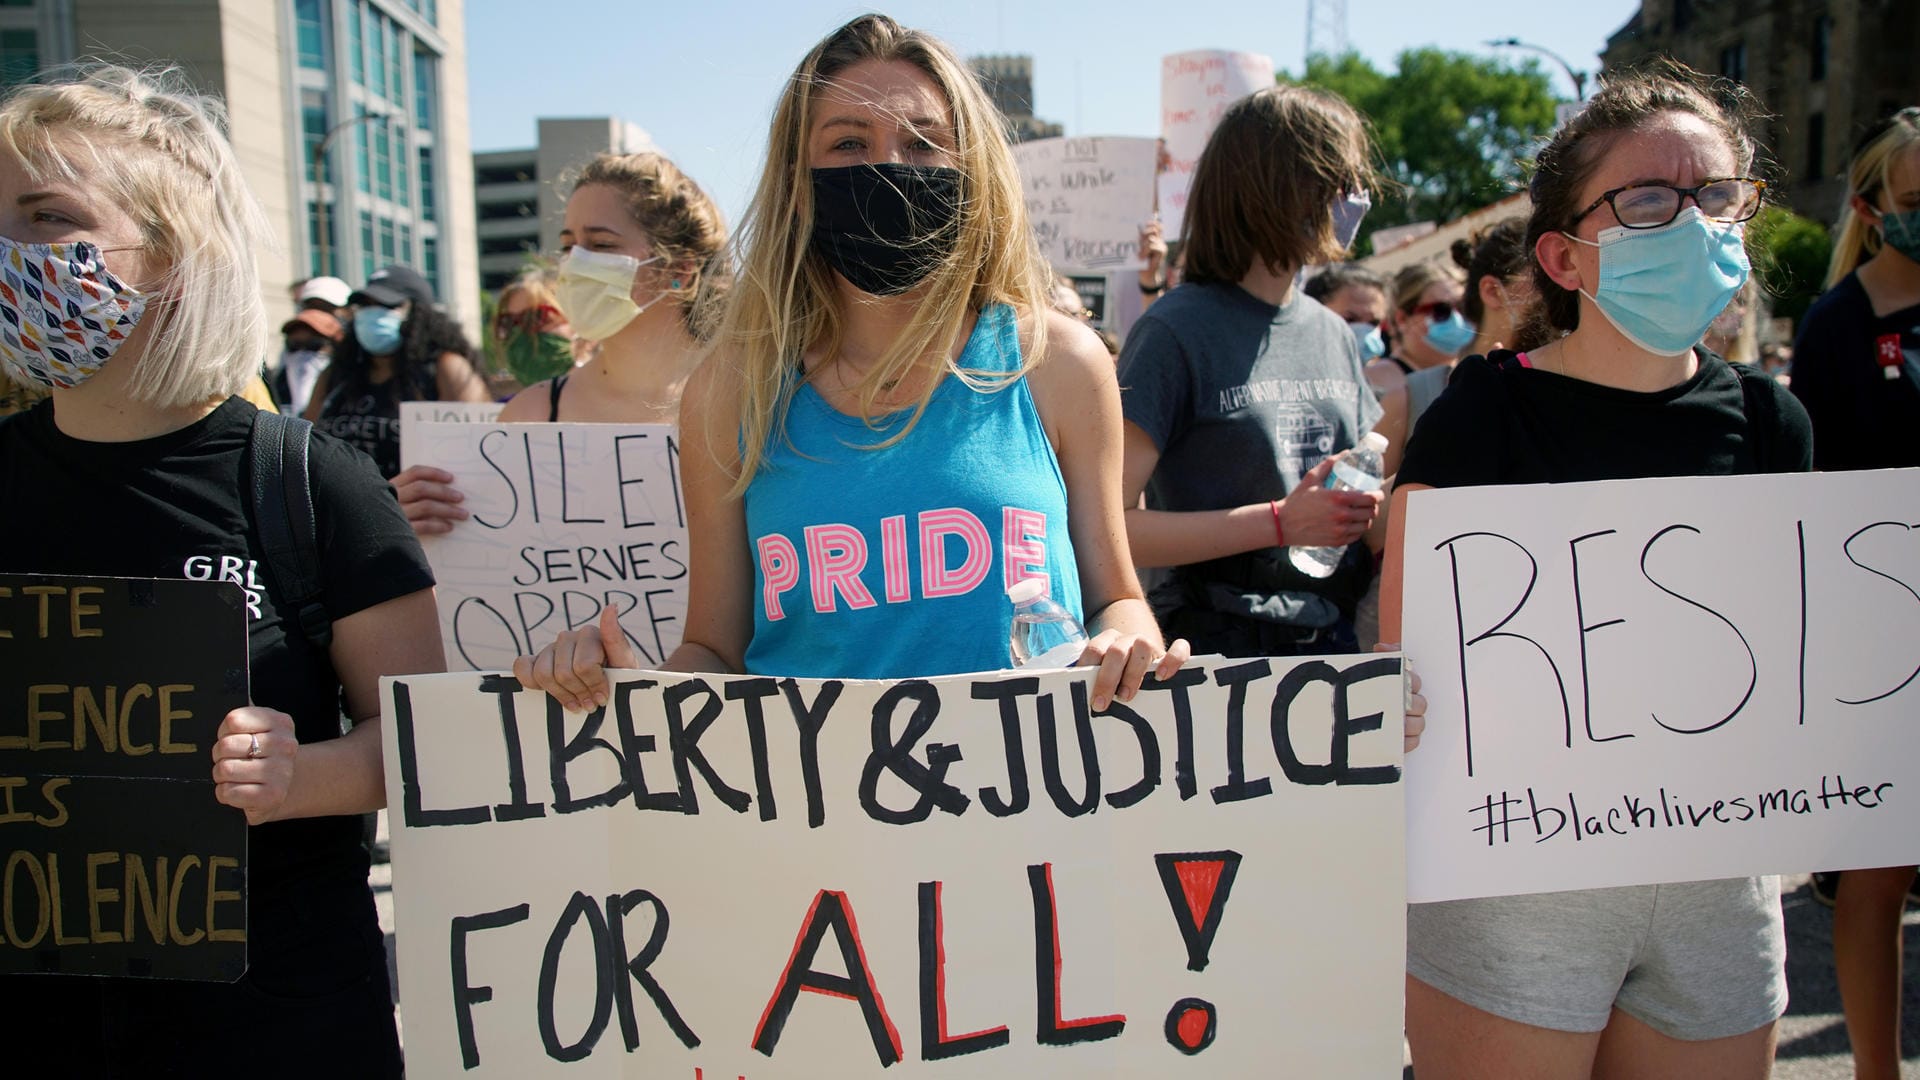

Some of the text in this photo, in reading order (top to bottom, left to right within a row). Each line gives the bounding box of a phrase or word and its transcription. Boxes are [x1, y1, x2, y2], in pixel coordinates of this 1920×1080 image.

[183, 555, 266, 590] GRL
[513, 541, 687, 586] SERVES
[757, 506, 1051, 622] PRIDE
[1434, 520, 1920, 777] RESIS
[393, 657, 1401, 828] LIBERTY & JUSTICE
[1468, 774, 1894, 846] #blacklivesmatter
[451, 888, 702, 1070] FOR
